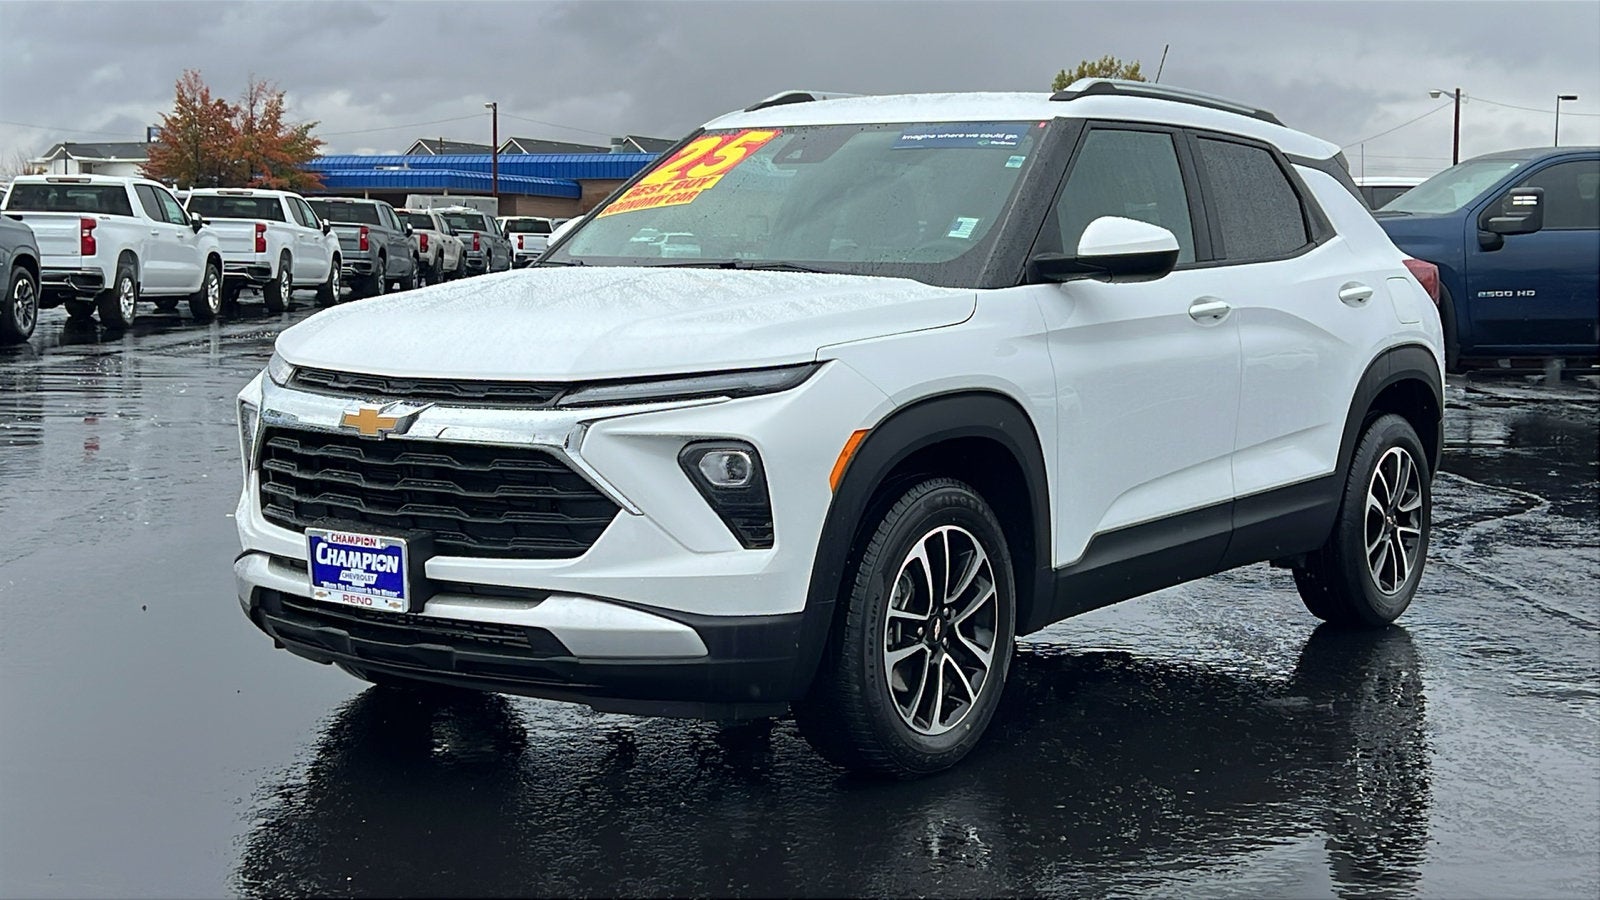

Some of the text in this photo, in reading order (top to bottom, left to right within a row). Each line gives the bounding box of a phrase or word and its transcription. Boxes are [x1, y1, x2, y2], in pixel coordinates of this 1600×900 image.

[638, 130, 777, 186] 25
[625, 176, 716, 199] BEST BUY
[665, 190, 699, 204] CAR
[1477, 290, 1513, 298] 2500
[331, 533, 377, 547] CHAMPION
[341, 572, 374, 582] CHEVROLET
[343, 594, 373, 606] RENO
